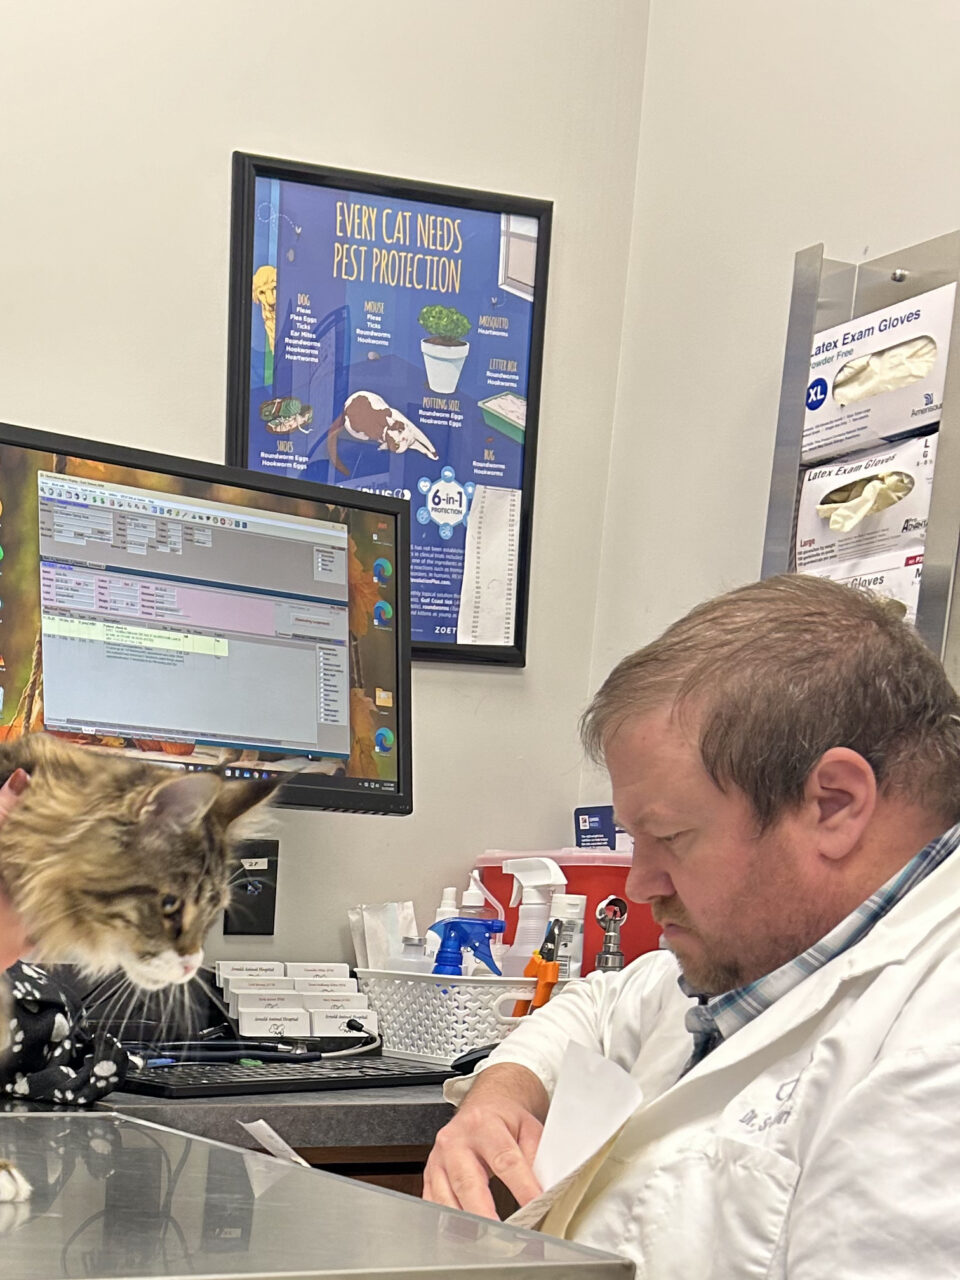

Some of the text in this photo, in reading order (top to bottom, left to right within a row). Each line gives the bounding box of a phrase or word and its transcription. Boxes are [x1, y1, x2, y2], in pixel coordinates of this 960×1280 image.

[336, 201, 463, 253] EVERY CAT NEEDS
[333, 242, 462, 294] PEST PROTECTION
[297, 293, 311, 306] DOG
[296, 306, 312, 314] Fleas
[364, 300, 385, 314] MOUSE
[289, 313, 318, 323] Flea Eggs
[366, 314, 382, 322] Fleas
[479, 315, 509, 330] MOSQUITO
[296, 322, 311, 330] Ticks
[842, 325, 874, 346] Exam
[878, 308, 921, 333] Gloves
[301, 331, 316, 339] Mites
[355, 328, 391, 339] Roundworms
[477, 328, 509, 337] Heartworms
[284, 337, 321, 347] Roundworms
[357, 336, 389, 346] Hookworms
[285, 345, 319, 355] Hookworms
[285, 353, 319, 363] Heartworms
[810, 348, 854, 369] owder Free
[489, 358, 518, 372] LITTER BOX
[486, 371, 519, 380] Roundworms
[487, 379, 517, 388] Hookworms
[808, 385, 825, 403] XL
[423, 397, 448, 410] POTTING
[419, 410, 464, 420] Roundworm Eggs
[420, 418, 462, 428] Hookworm Eggs
[277, 440, 294, 452] SHOES
[924, 438, 930, 448] L
[260, 452, 309, 462] Roundworm Eggs
[484, 448, 495, 460] BUG
[923, 450, 928, 458] G
[262, 460, 307, 470] Hookworm Eggs
[472, 460, 506, 469] Roundworms
[807, 454, 897, 482] Latex Exam Gloves
[473, 468, 504, 477] Hookworms
[432, 488, 462, 508] 6-in-1
[431, 507, 462, 515] PROTECTION
[800, 538, 815, 548] Large
[850, 575, 884, 589] Gloves
